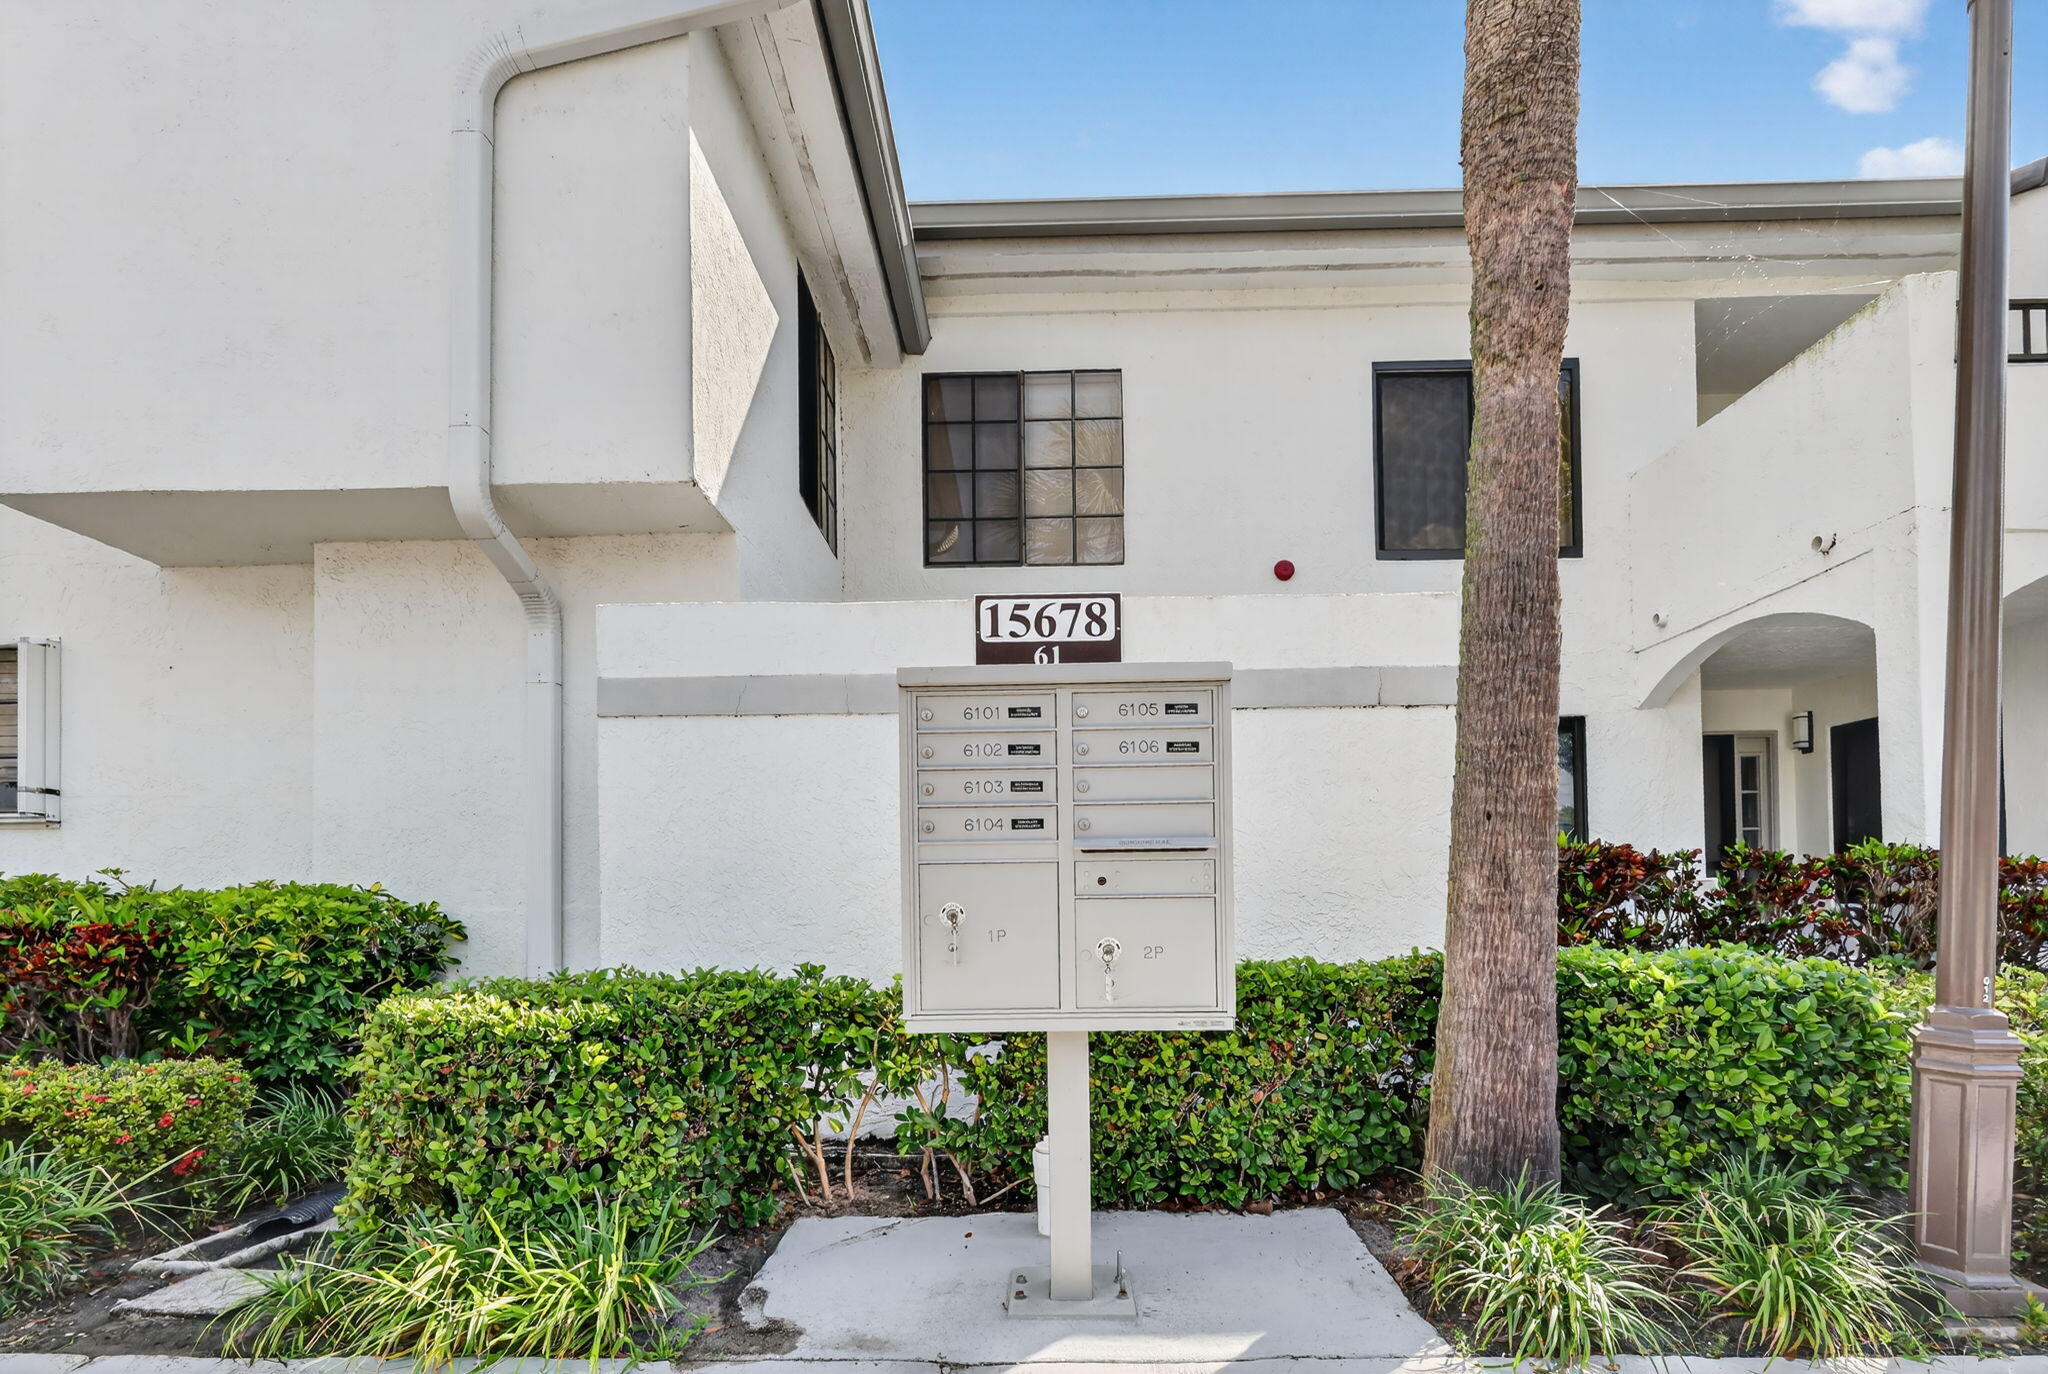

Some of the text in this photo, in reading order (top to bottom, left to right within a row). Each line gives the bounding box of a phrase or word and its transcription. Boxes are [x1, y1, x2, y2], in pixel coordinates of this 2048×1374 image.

[985, 602, 1107, 638] 15678
[1034, 645, 1060, 664] 61
[963, 706, 1000, 720] 6101
[1118, 703, 1159, 717] 6105
[963, 743, 1003, 757] 6102
[1119, 740, 1159, 754] 6106
[963, 781, 1004, 794] 6103
[964, 818, 1004, 832] 6104
[988, 929, 1007, 943] 1P
[1143, 945, 1164, 959] 2P
